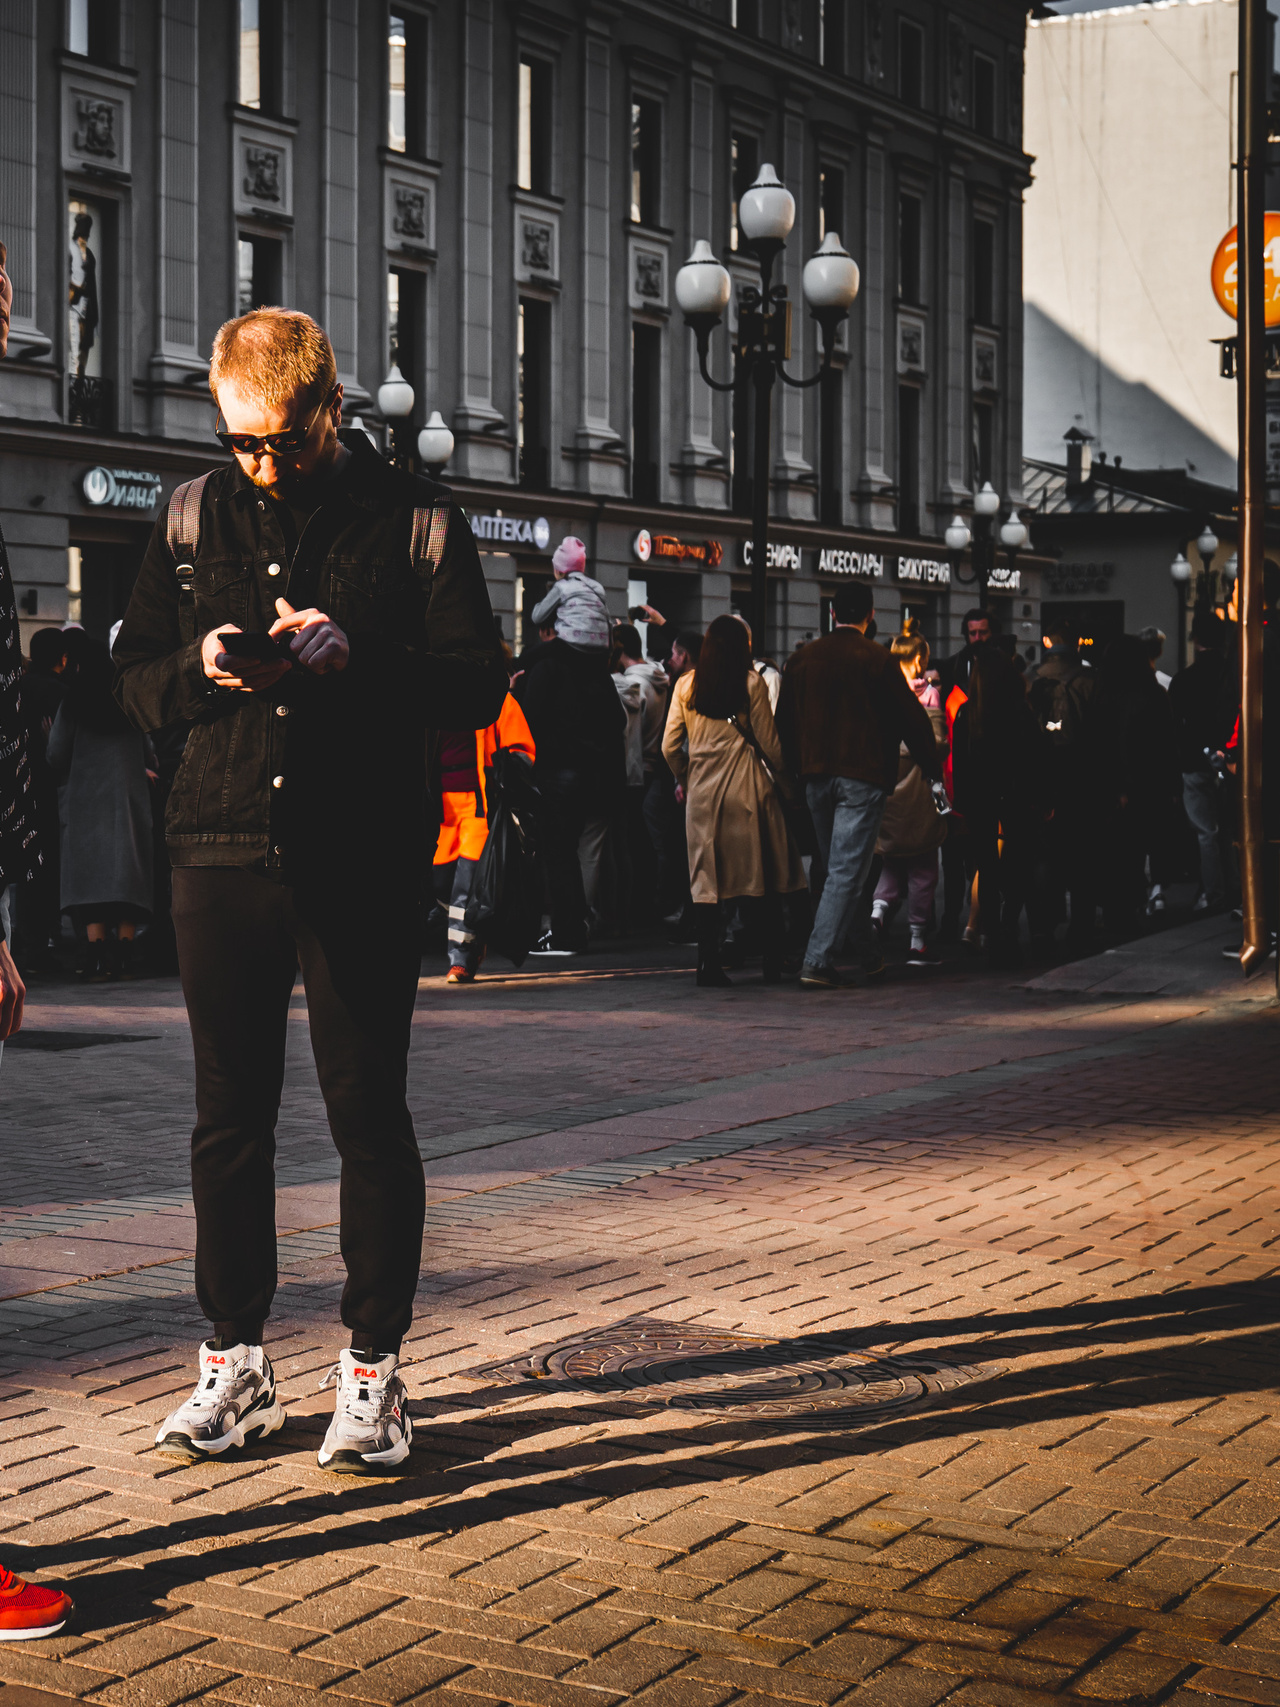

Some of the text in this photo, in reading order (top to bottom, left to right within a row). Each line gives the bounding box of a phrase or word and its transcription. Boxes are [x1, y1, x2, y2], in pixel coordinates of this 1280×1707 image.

[470, 515, 534, 544] АПТЕКА
[743, 541, 951, 584] СЕНИРЫ АКСЕССУАРЫ БИЖУТЕРИЯ
[205, 1355, 226, 1365] FILA
[354, 1368, 377, 1378] FILA
